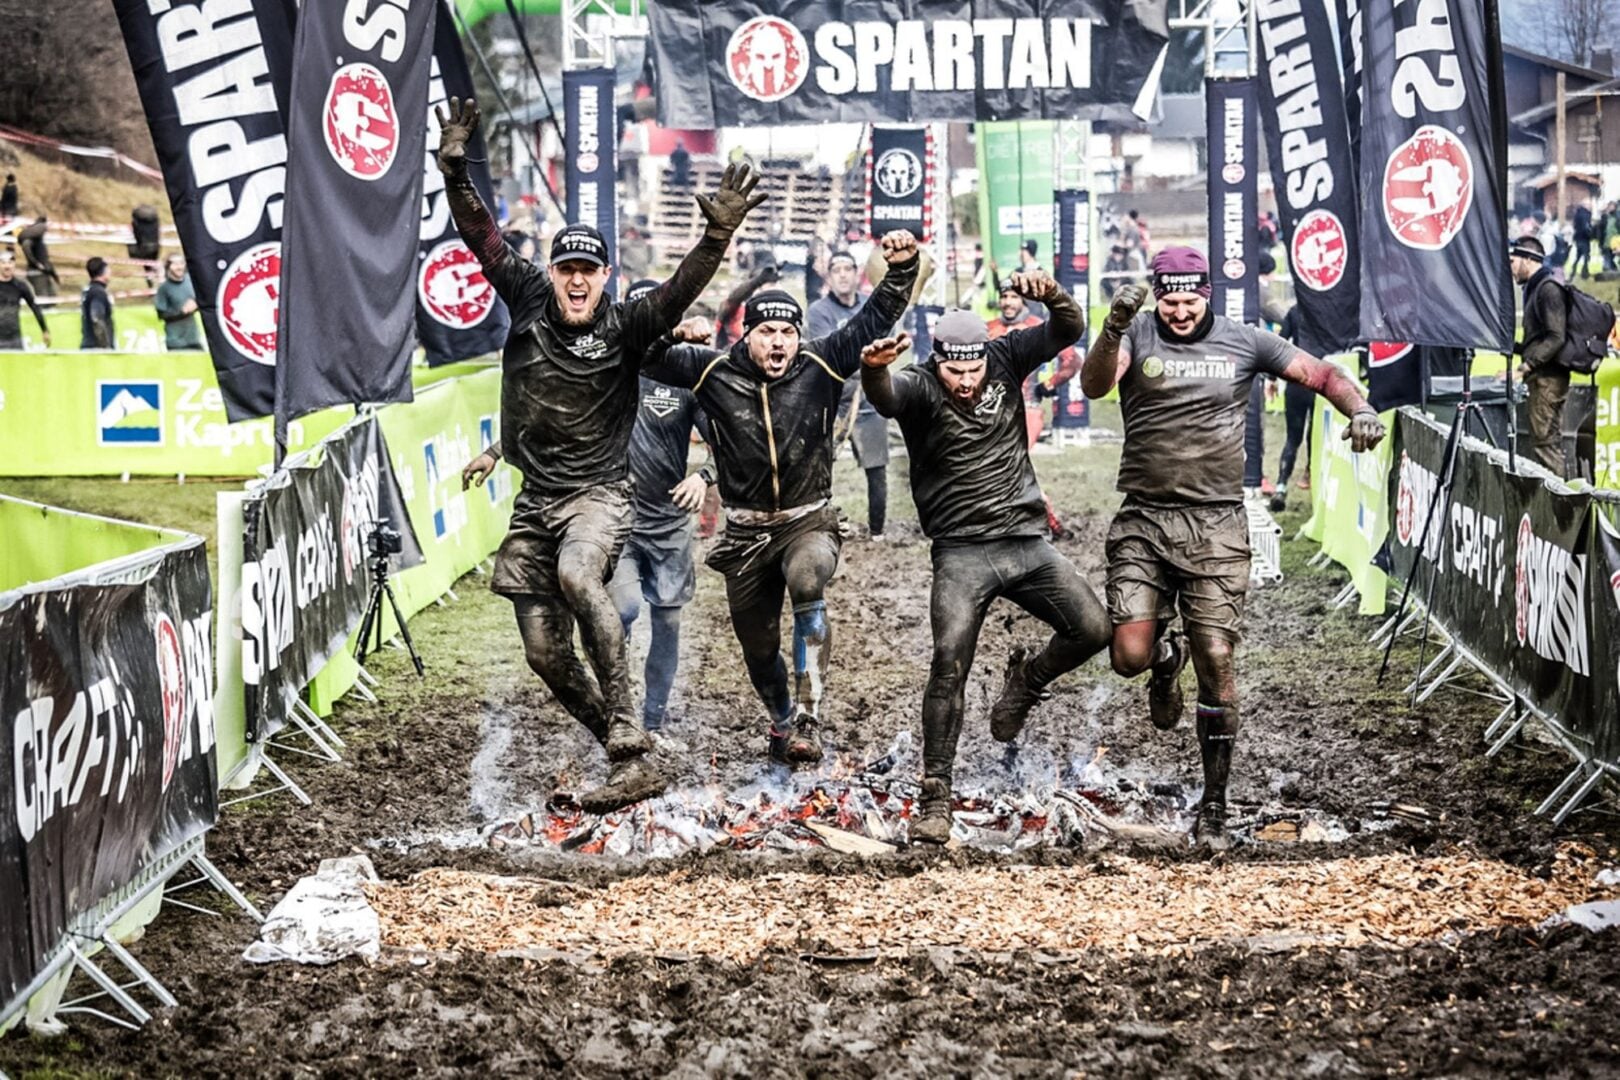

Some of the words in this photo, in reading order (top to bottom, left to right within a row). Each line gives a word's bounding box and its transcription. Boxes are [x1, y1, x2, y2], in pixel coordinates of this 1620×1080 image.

[814, 17, 1092, 94] SPARTAN
[147, 0, 291, 243] SPAR
[578, 85, 599, 153] SPARTAN
[1223, 97, 1244, 164] SPARTAN
[578, 181, 598, 229] ARTAN
[873, 205, 923, 220] SPARTAN
[1223, 192, 1244, 259] SPARTAN
[1170, 274, 1201, 285] SPARTAN
[175, 379, 225, 412] Ze
[1164, 360, 1236, 379] SPARTAN
[1451, 502, 1497, 591] CRAFT
[14, 676, 119, 843] CRAFT
